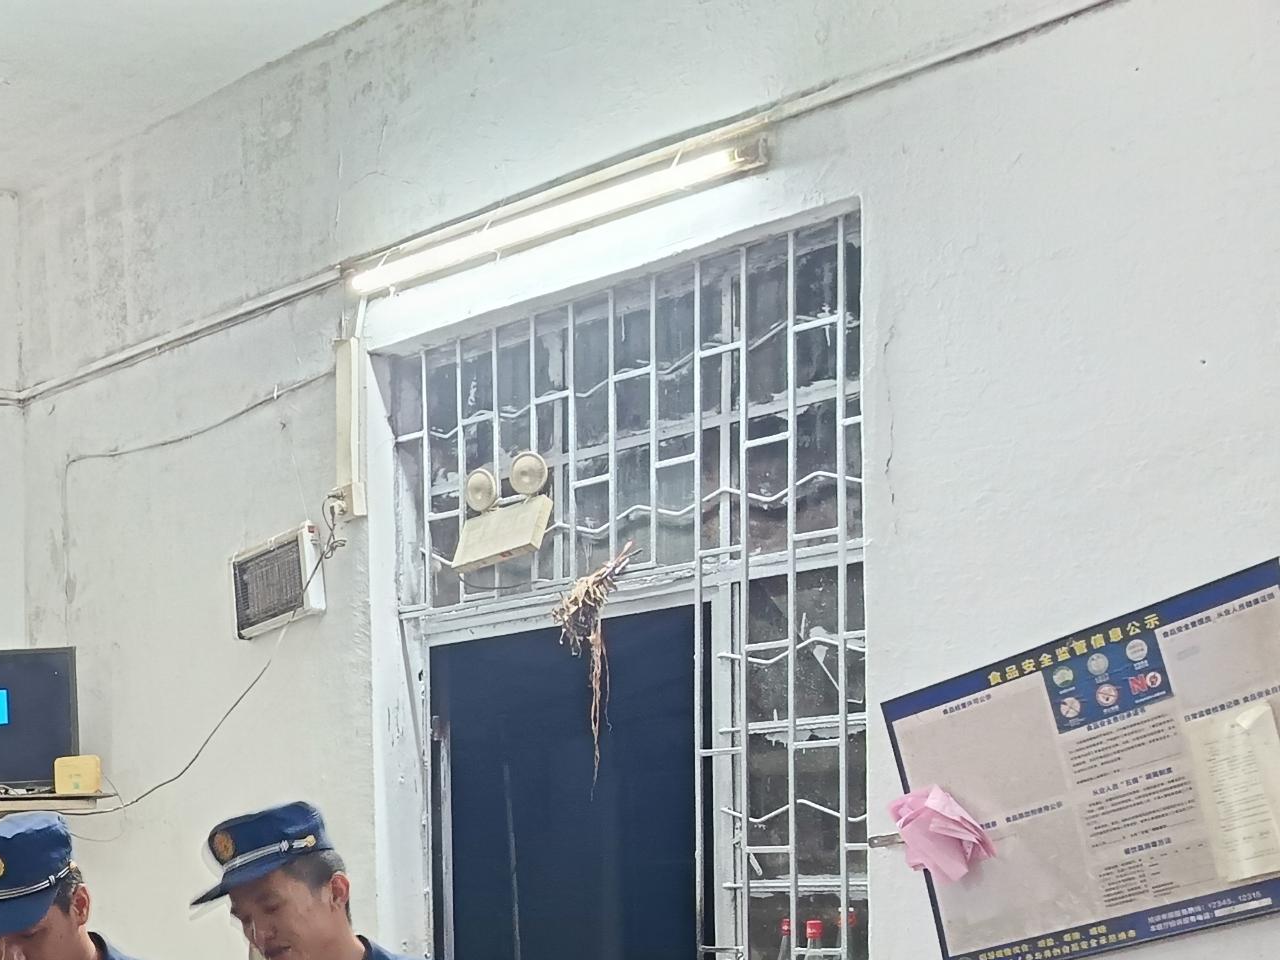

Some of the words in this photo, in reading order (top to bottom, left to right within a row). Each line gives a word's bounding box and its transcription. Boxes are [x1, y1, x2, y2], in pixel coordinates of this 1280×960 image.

[987, 613, 1160, 686] 食品安全监管信息公示
